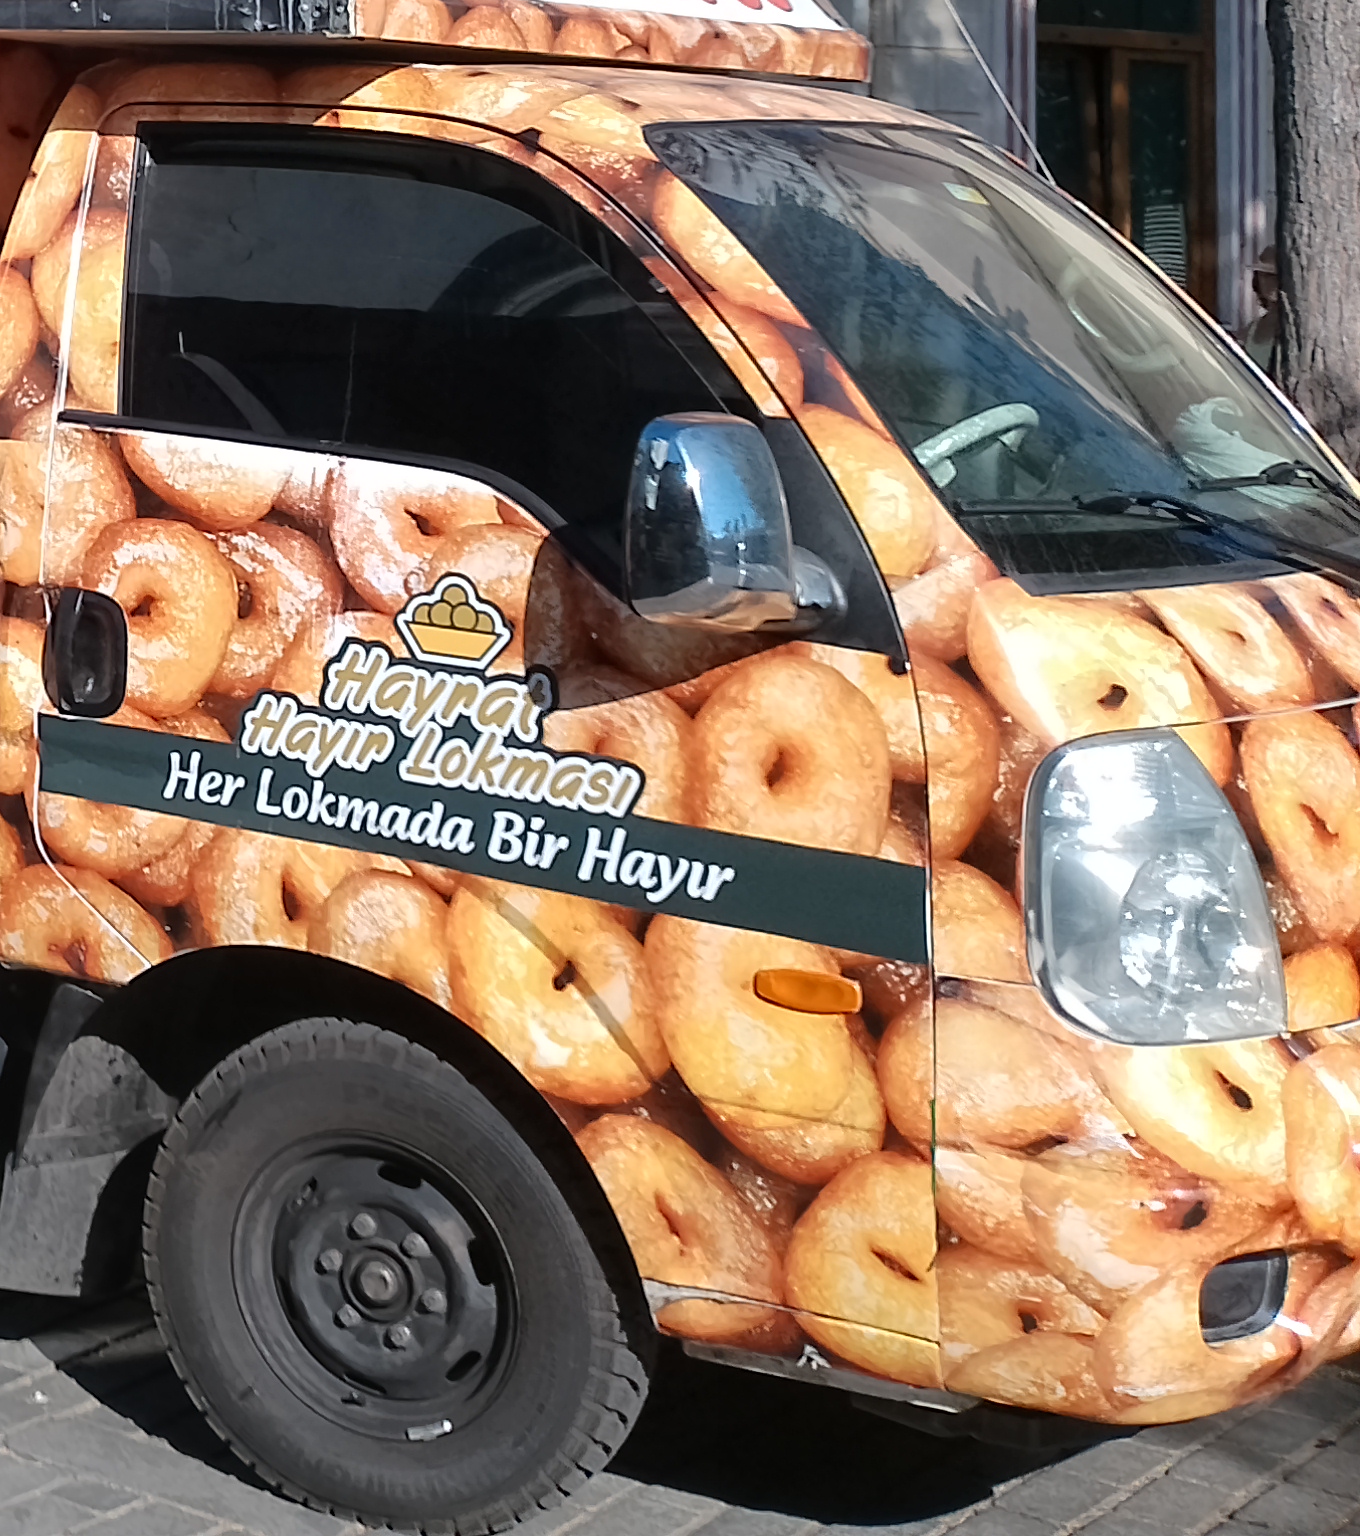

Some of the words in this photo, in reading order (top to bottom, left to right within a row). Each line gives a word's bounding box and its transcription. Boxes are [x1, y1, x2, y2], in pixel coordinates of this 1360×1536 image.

[243, 695, 394, 778] Hayır
[399, 722, 641, 817] Lokması
[163, 751, 245, 807] Her
[256, 768, 475, 855] Lokmada
[488, 810, 570, 869] Bir
[578, 827, 735, 904] Hayır
